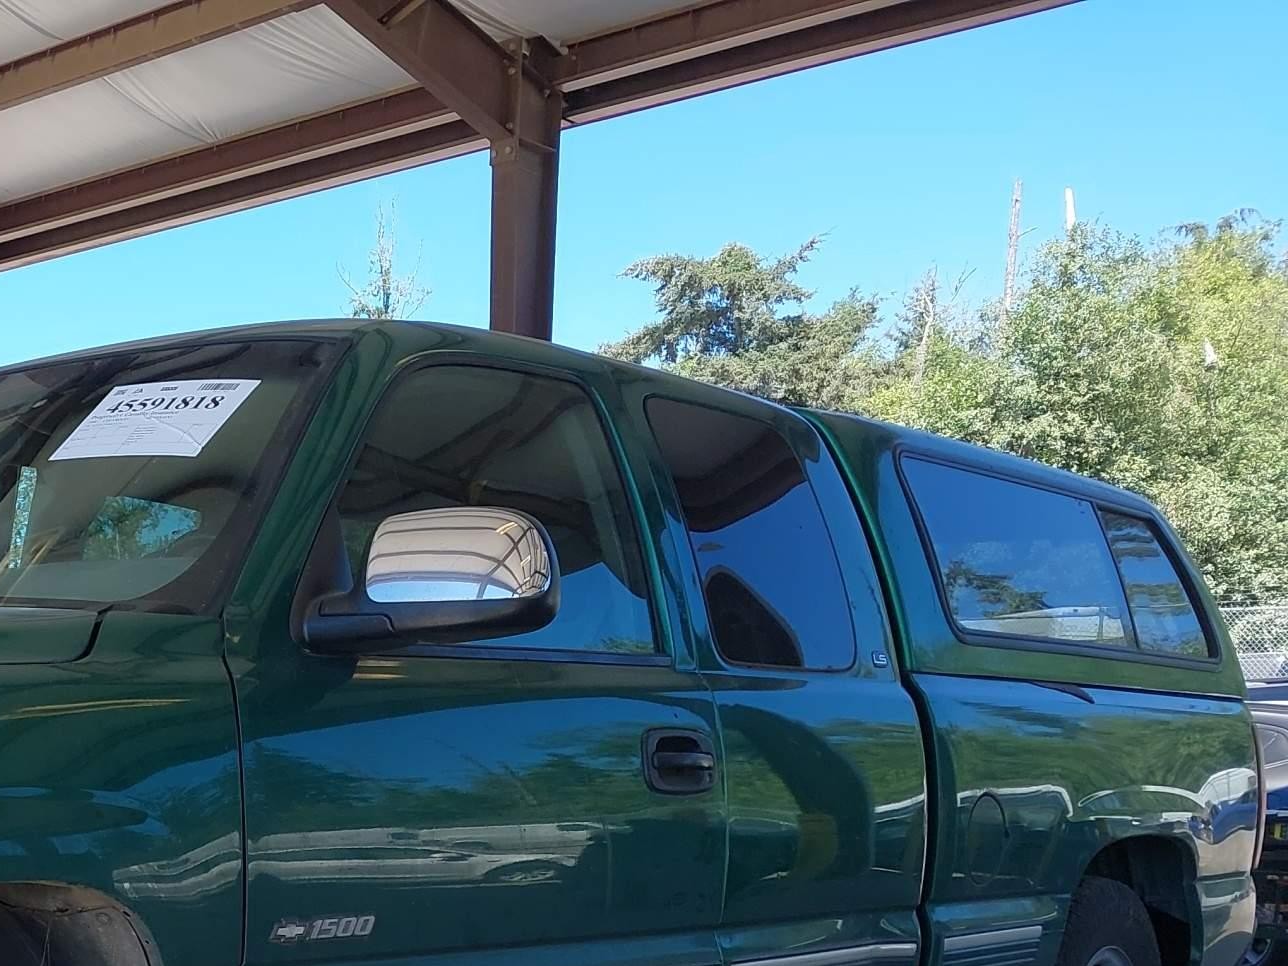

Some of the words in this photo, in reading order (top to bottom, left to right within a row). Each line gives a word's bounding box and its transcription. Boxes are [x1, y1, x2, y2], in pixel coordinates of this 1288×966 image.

[106, 395, 225, 413] 45591818
[873, 654, 887, 664] LS
[308, 915, 376, 940] 1500
